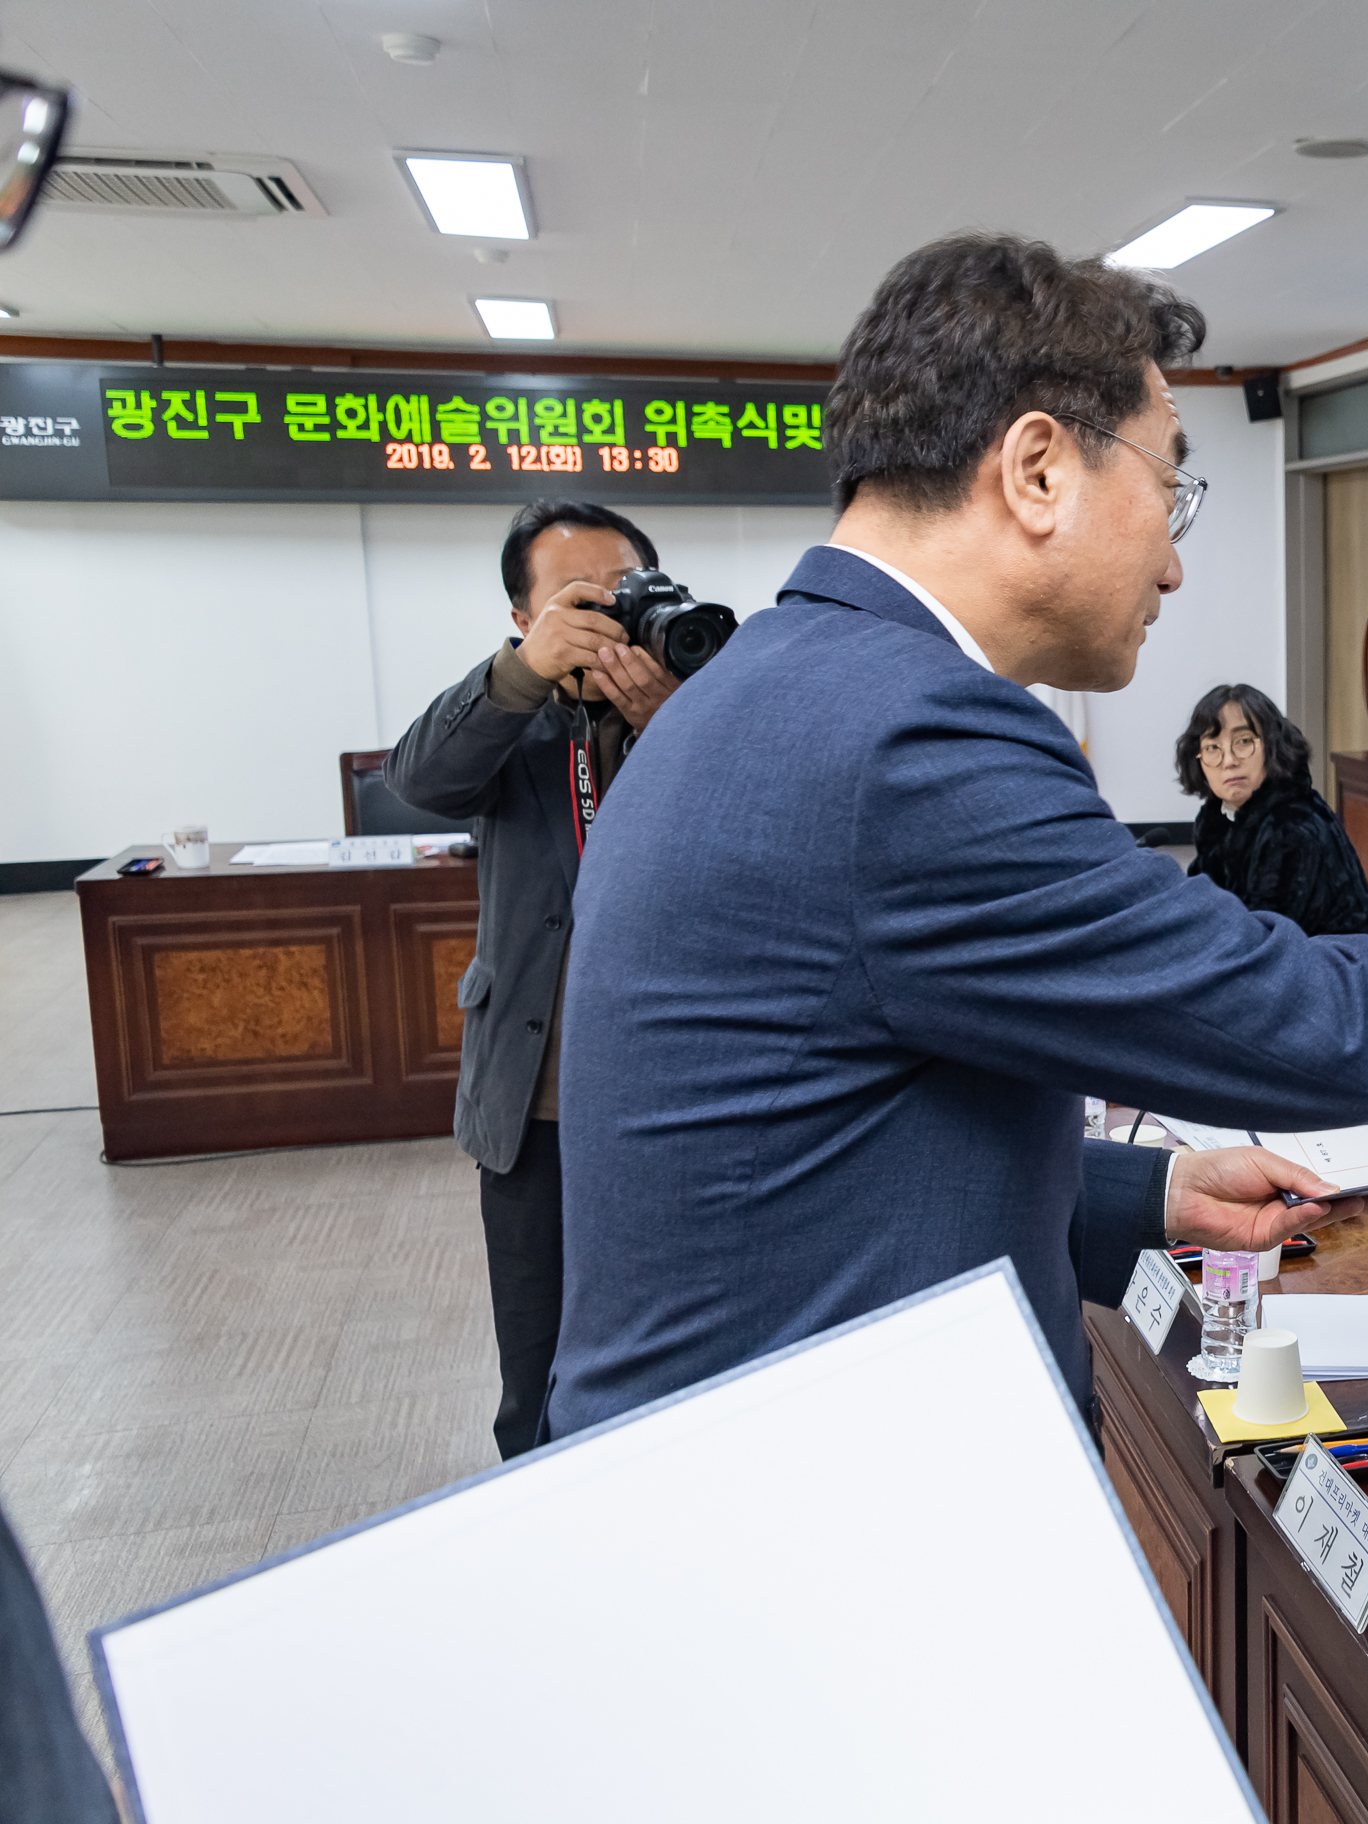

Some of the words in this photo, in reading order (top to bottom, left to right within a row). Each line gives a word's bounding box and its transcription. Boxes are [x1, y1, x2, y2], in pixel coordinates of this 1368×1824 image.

[0, 415, 82, 436] 광진구
[105, 389, 262, 440] 광진구
[283, 392, 626, 446] 문화예술위원회
[643, 399, 823, 450] 위촉식및
[385, 442, 455, 470] 2019.
[468, 443, 492, 471] 2.
[648, 584, 675, 593] Canon
[577, 748, 592, 794] EOS
[581, 797, 596, 821] 5D
[1318, 1469, 1361, 1527] 건대프리마켓
